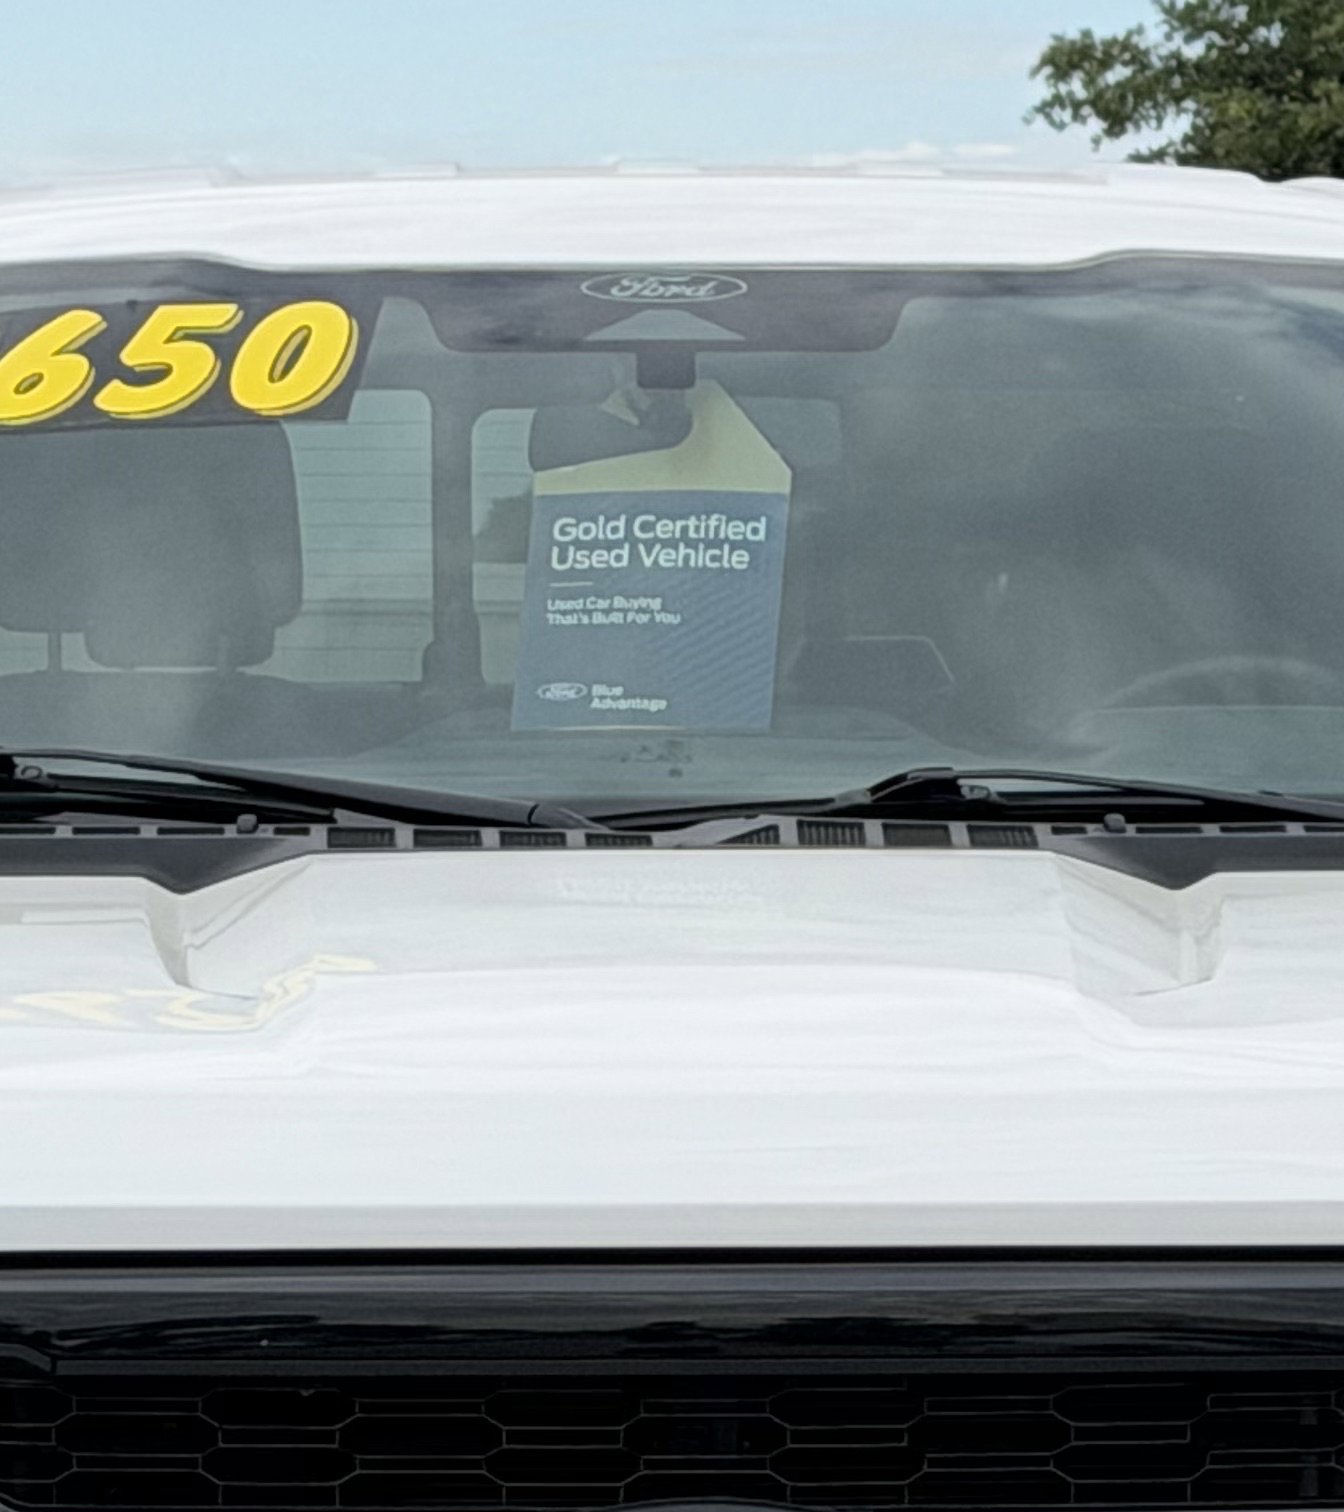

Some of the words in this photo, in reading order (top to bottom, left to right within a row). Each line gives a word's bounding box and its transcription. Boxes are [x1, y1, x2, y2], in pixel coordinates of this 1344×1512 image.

[609, 274, 719, 297] Ford
[553, 514, 626, 542] Gold
[633, 513, 767, 542] Certified
[551, 542, 629, 570] Used
[638, 542, 750, 570] Vehicle
[547, 598, 584, 611] Used
[586, 597, 611, 610] Car
[627, 611, 651, 624] For
[654, 611, 681, 625] You
[592, 684, 624, 696] Blue
[590, 697, 668, 712] Advantage
